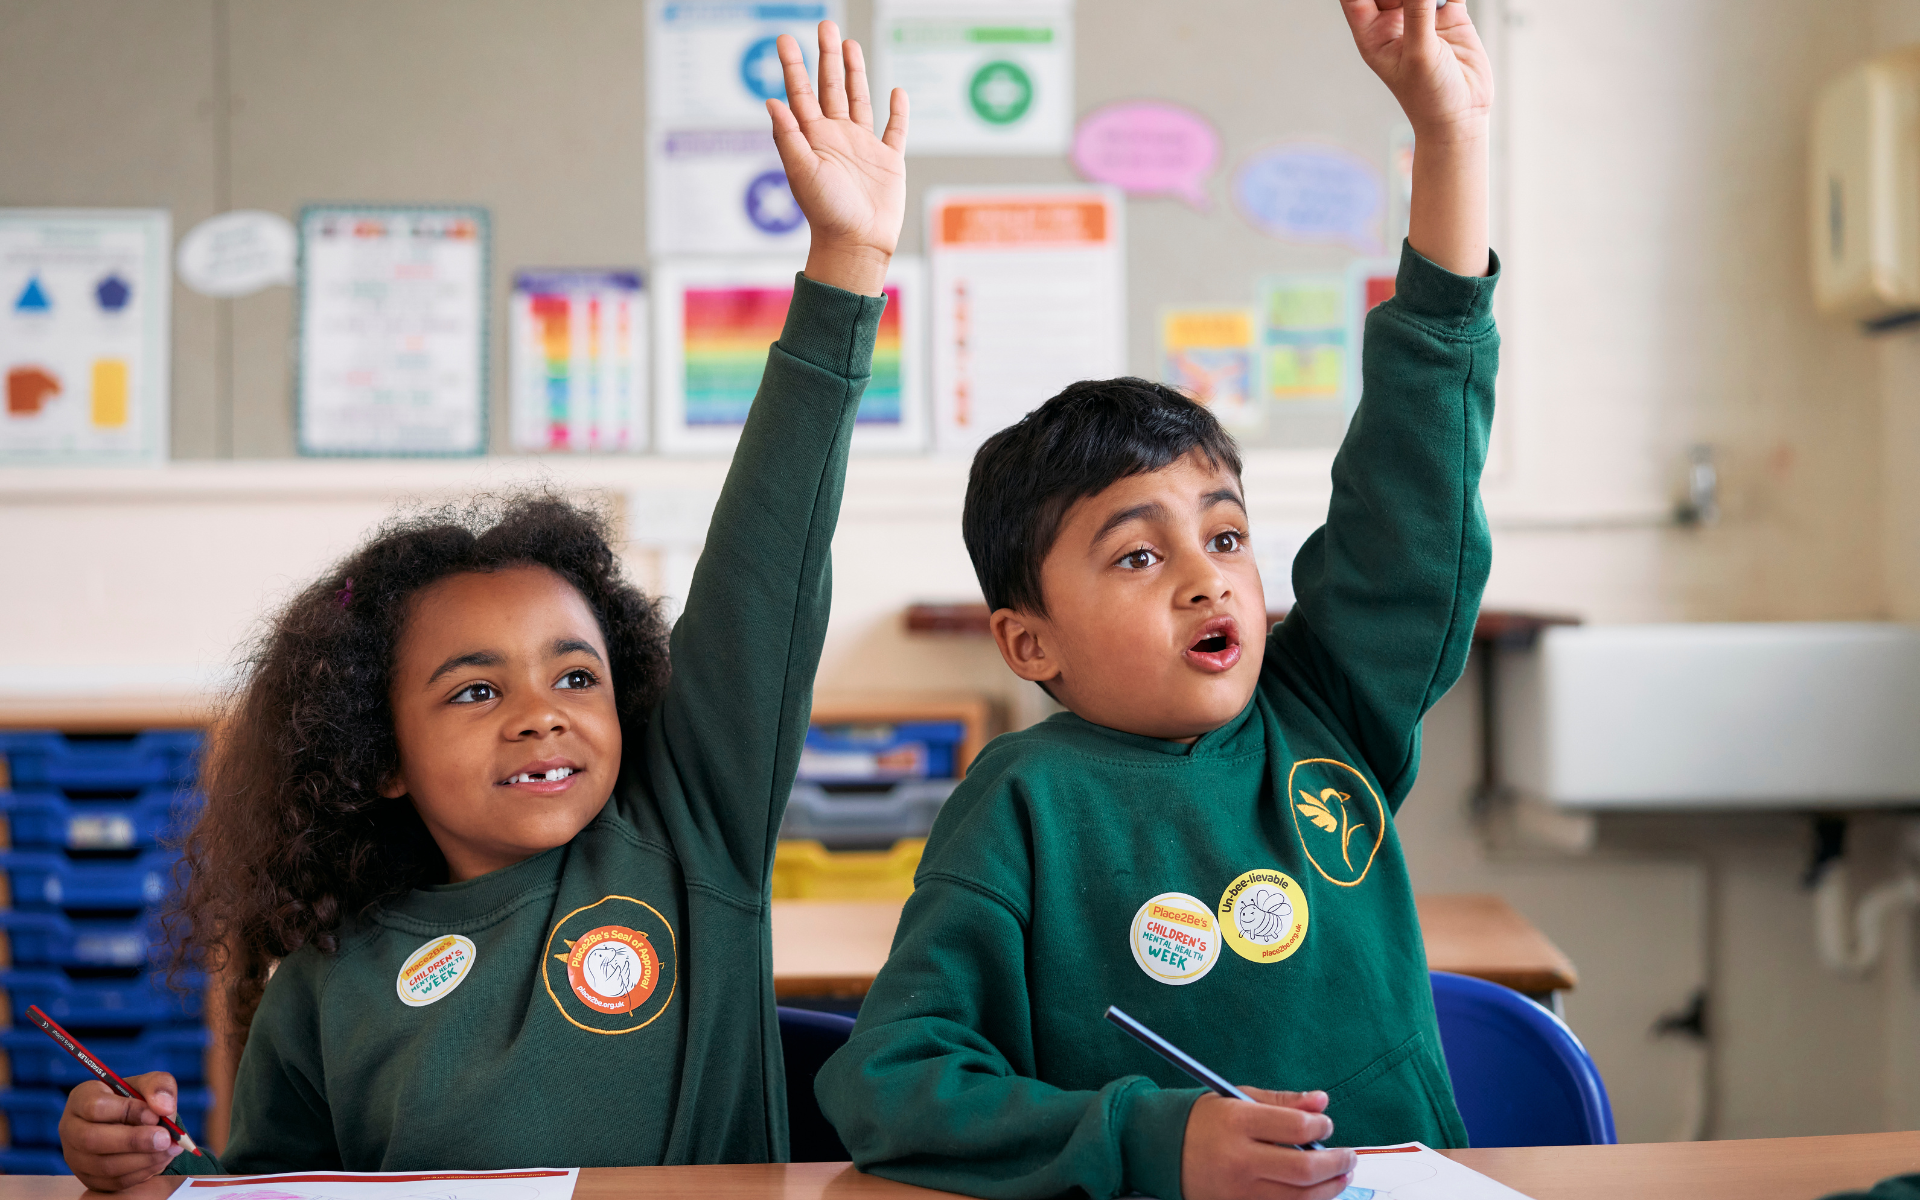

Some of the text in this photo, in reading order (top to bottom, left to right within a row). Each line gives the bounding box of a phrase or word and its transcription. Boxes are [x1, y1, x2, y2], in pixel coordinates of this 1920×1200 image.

[1222, 873, 1288, 913] Un-bee-lievable
[1153, 906, 1208, 928] Place2Be's
[1142, 932, 1204, 962] MENTAL HEALTH
[1146, 922, 1206, 952] CHILDREN'S
[1262, 924, 1302, 958] place2be.org.uk
[406, 940, 452, 976] Place2Be's
[409, 950, 462, 986] CHILDREN'S
[572, 930, 652, 990] Place2Be's Seal of Approval
[1148, 945, 1188, 971] WEEK
[411, 956, 465, 993] MENTAL HEALTH
[421, 967, 458, 994] WEEK
[576, 986, 624, 1010] place2be.org.uk
[78, 1051, 104, 1075] STAEDTLER
